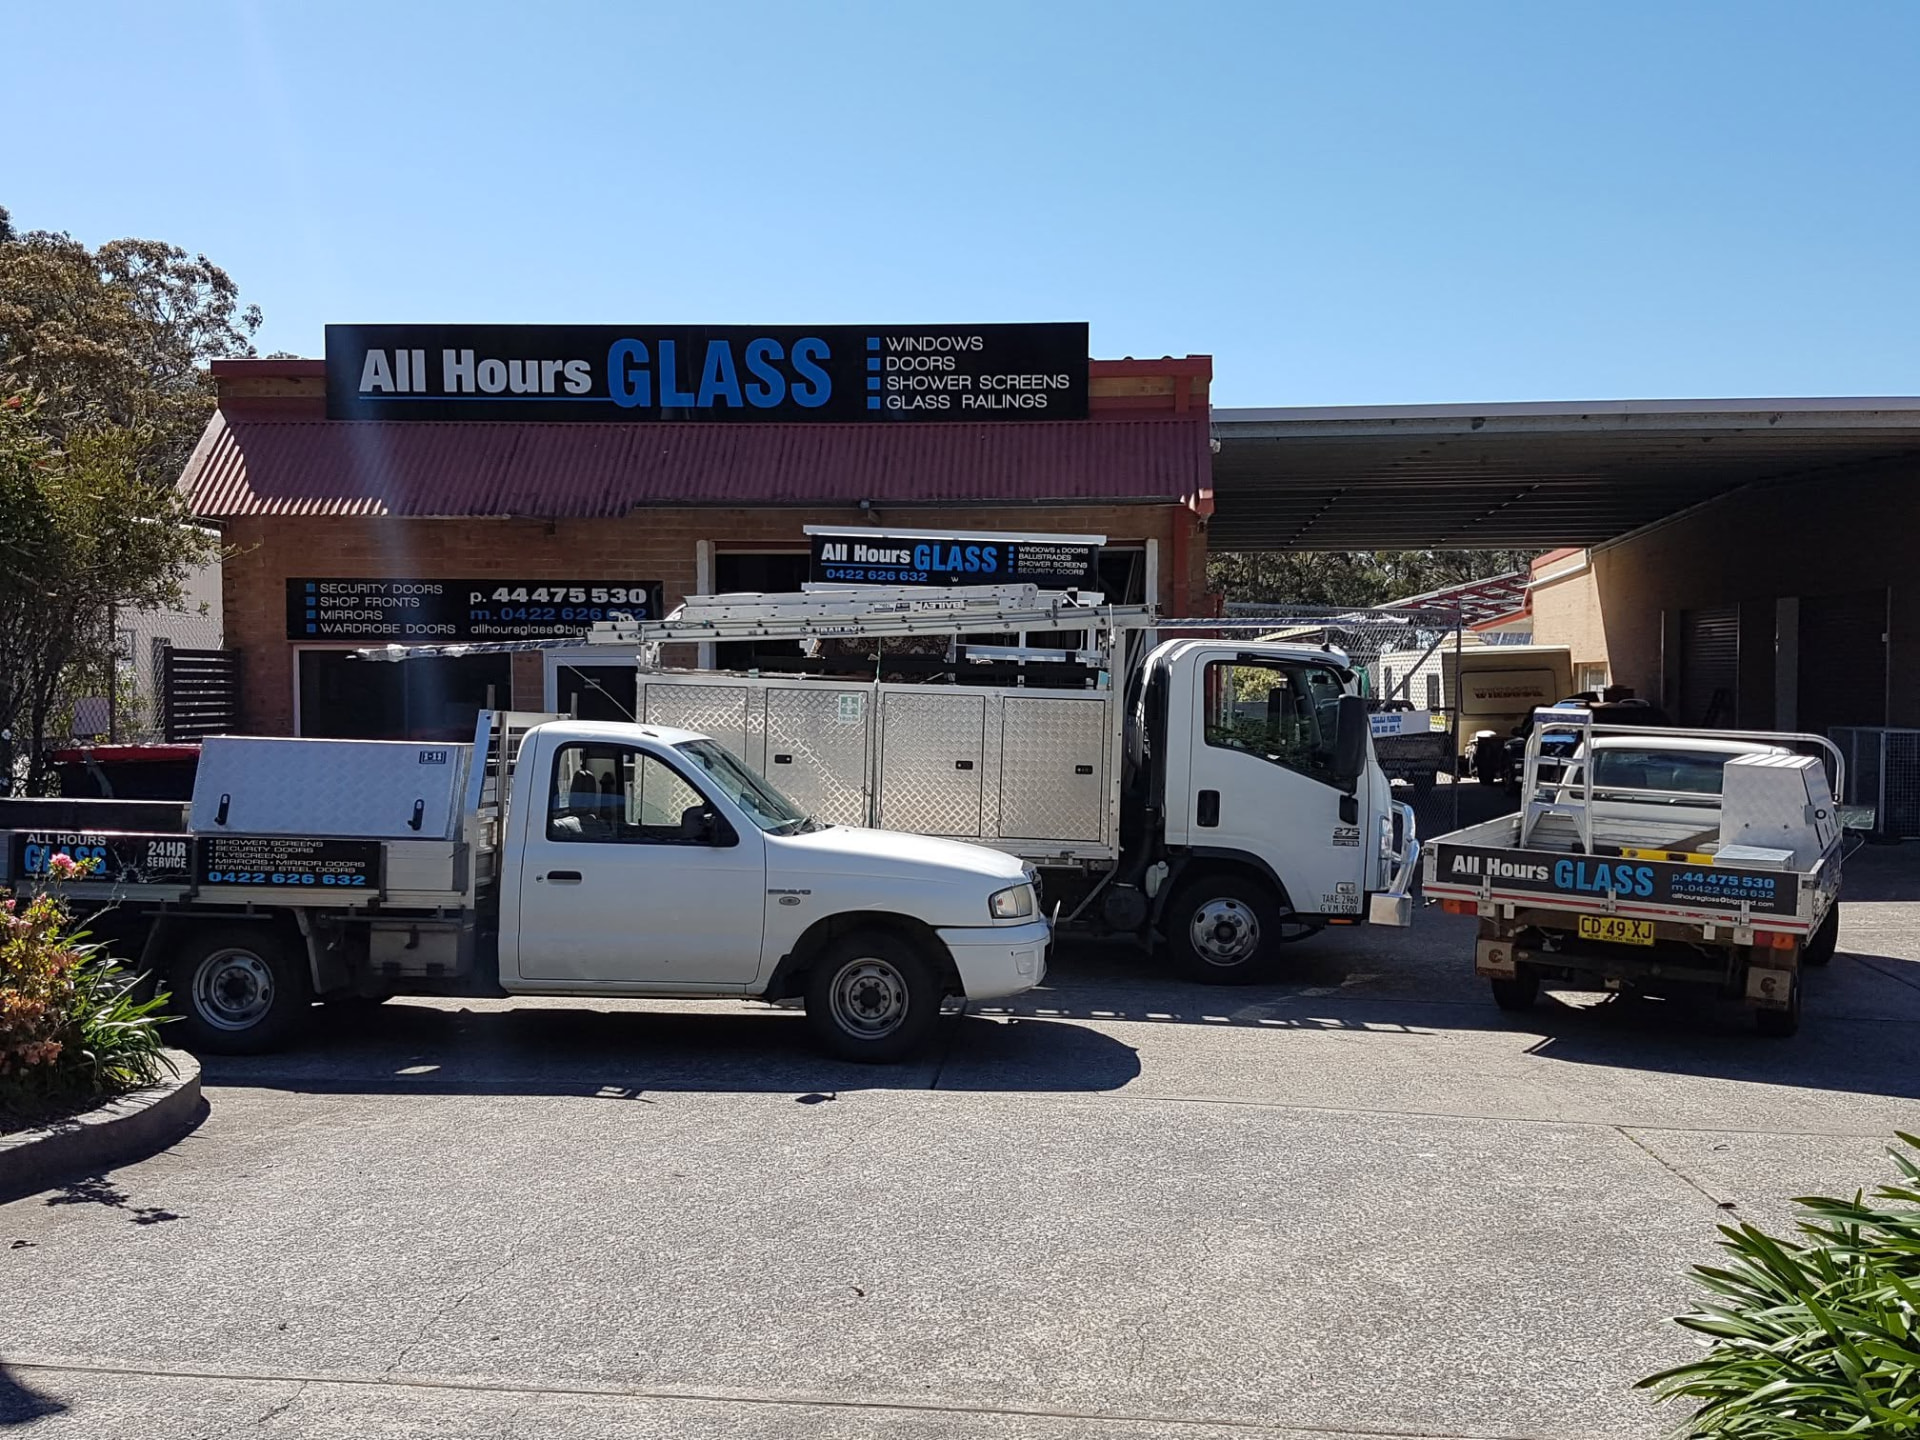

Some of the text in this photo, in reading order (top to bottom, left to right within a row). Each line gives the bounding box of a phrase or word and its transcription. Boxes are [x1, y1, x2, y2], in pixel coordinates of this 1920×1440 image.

[886, 335, 984, 352] WINDOWS
[886, 356, 956, 372] DOORS
[358, 337, 832, 409] All Hours GLASS
[886, 374, 1070, 391] SHOWER SCREENS
[886, 393, 1047, 410] GLASS RAILINGS
[1018, 546, 1056, 554] WINDOWS
[1061, 547, 1089, 555] DOORS
[821, 543, 998, 573] All Hours GLASS
[1018, 560, 1088, 569] SHOWER SCREENS
[826, 568, 928, 582] 0422 626 632
[1017, 567, 1085, 576] SECURITY DOORS
[319, 583, 443, 595] SECURITY DOORS
[591, 588, 647, 603] 530
[319, 596, 420, 608] SHOP FRONTS
[319, 610, 383, 620] MIRRORS
[561, 607, 602, 621] 626
[319, 623, 456, 634] WARDROBE DOORS
[1334, 828, 1360, 836] 275
[26, 834, 107, 846] ALL HOURS
[270, 840, 324, 848] SCREENS
[148, 841, 187, 857] 24HR
[146, 856, 187, 868] SERVICE
[214, 858, 268, 866] MIRRORS
[275, 859, 322, 867] MIRROR
[214, 864, 275, 872] STAINLESS
[208, 871, 366, 885] 0422 626 632
[1452, 855, 1654, 897] All Hours GLASS
[1723, 886, 1747, 897] 626
